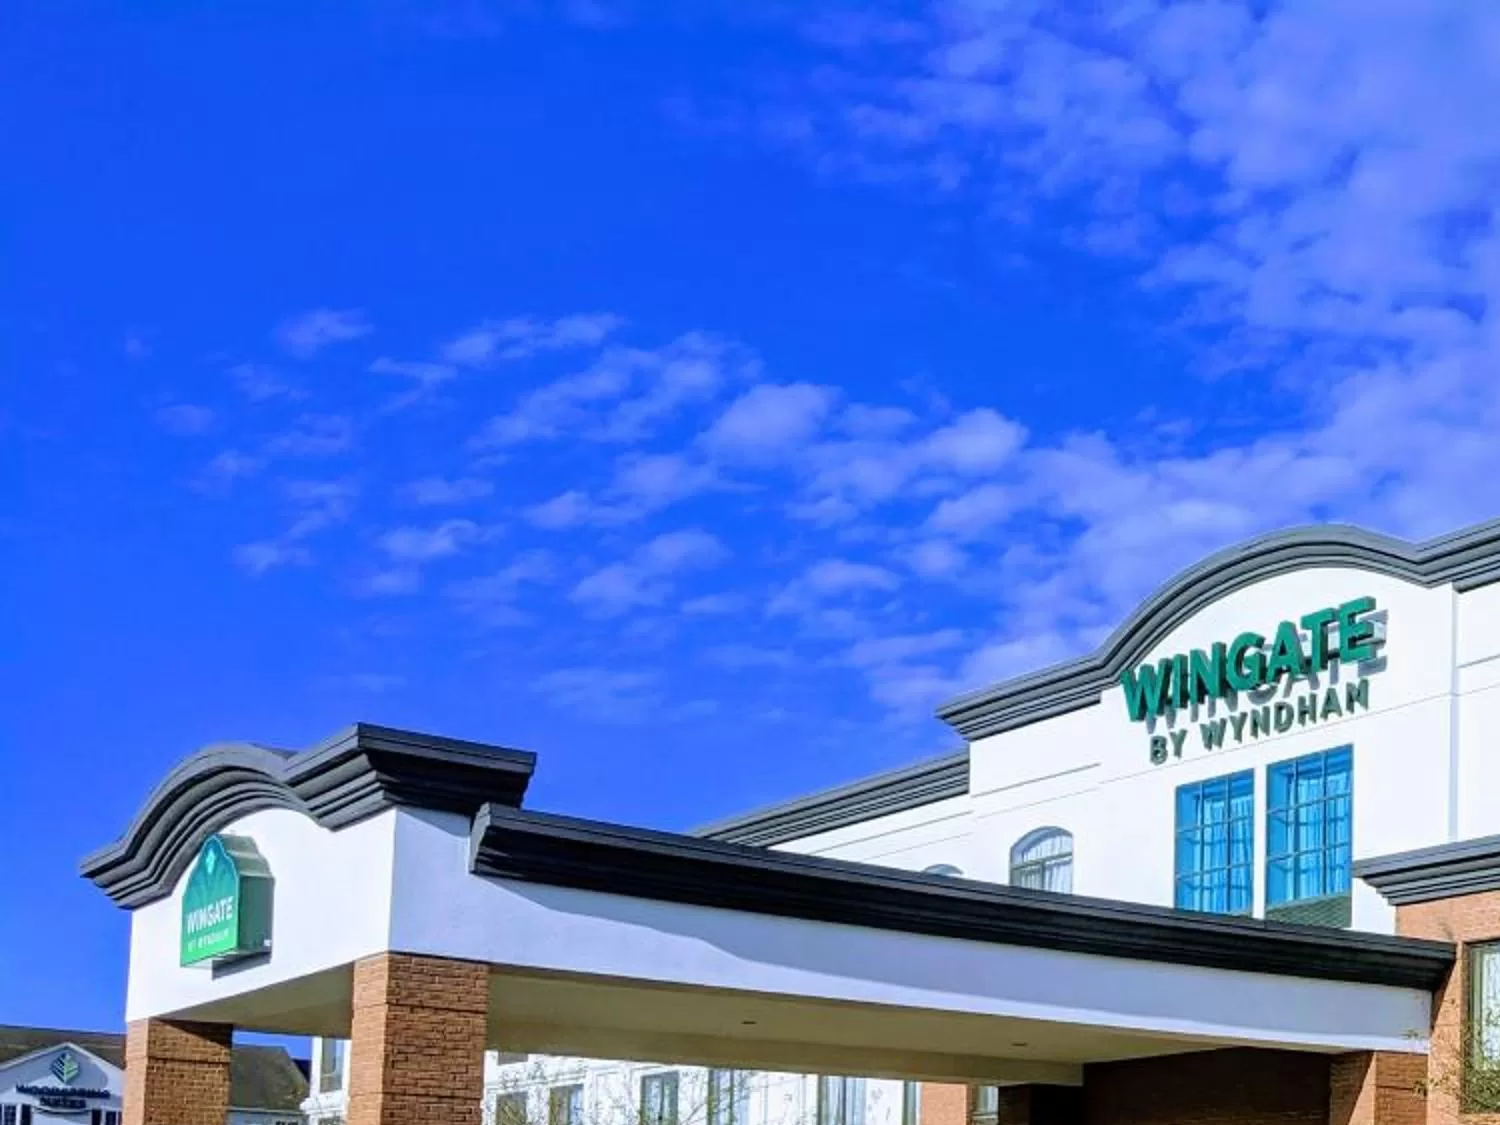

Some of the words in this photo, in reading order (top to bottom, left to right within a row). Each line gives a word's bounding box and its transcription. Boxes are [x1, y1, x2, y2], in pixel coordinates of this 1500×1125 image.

[1121, 596, 1377, 722] WINGATE
[1150, 729, 1187, 765] BY
[1200, 679, 1369, 750] WYNDHAM
[187, 896, 233, 935] WINGATE
